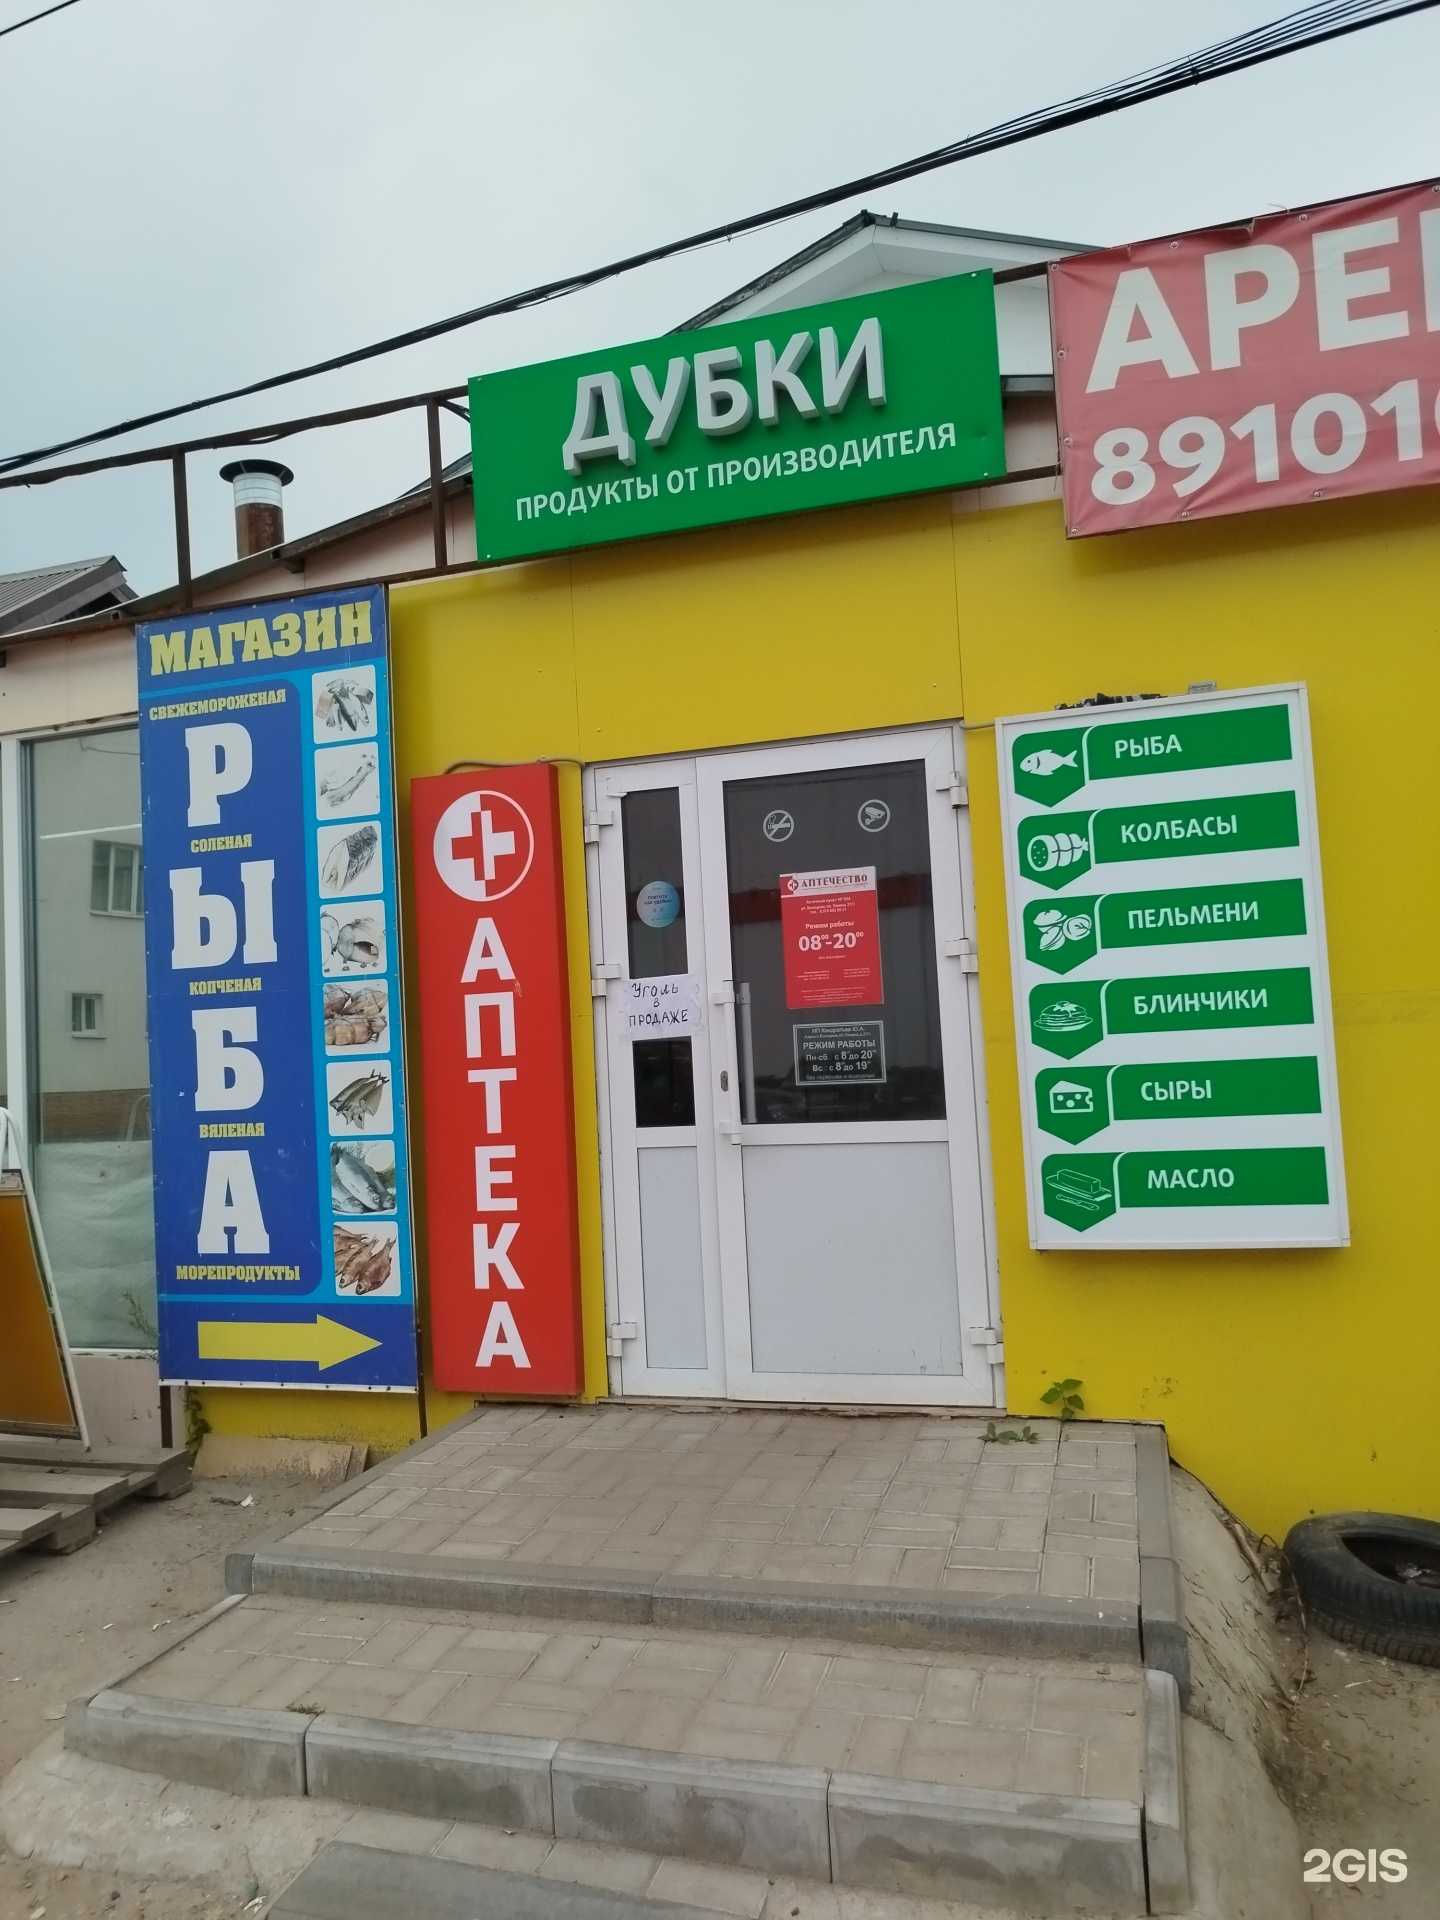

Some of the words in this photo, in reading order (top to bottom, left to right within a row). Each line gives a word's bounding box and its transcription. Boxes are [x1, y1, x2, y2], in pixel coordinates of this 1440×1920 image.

[1085, 208, 1440, 394] АРЕ
[562, 316, 887, 477] ДУБКИ
[1090, 378, 1440, 506] 89101
[515, 474, 659, 521] ПРОДУКТЫ
[667, 466, 698, 494] ОТ
[707, 422, 957, 489] ПРОИЗВОДИТЕЛЯ
[149, 599, 373, 677] МАГАЗИН
[148, 688, 287, 721] СВЕЖЕМОРОЖЕНАЯ
[1114, 734, 1183, 759] РЫБА
[1121, 814, 1238, 843] КОЛБАСЫ
[190, 833, 253, 853] СОЛЕНАЯ
[802, 874, 868, 888] АПТЕЧЕСТВО
[1127, 901, 1259, 930] ПЕЛЬМЕНИ
[189, 977, 262, 997] КОПЧЕНАЯ
[1133, 988, 1269, 1015] БЛИНЧИКИ
[628, 1009, 689, 1028] ПРОДАЖЕ
[803, 1040, 836, 1050] РЕЖИМ
[837, 1039, 876, 1049] РАБОТЫ
[1140, 1079, 1213, 1101] СЫРЫ
[199, 1122, 266, 1138] ВЯЛЕНАЯ
[460, 917, 532, 1369] АПТЕКА
[1147, 1168, 1235, 1189] МАСЛО
[176, 1265, 301, 1282] МОРЕПРОДУКТЫ
